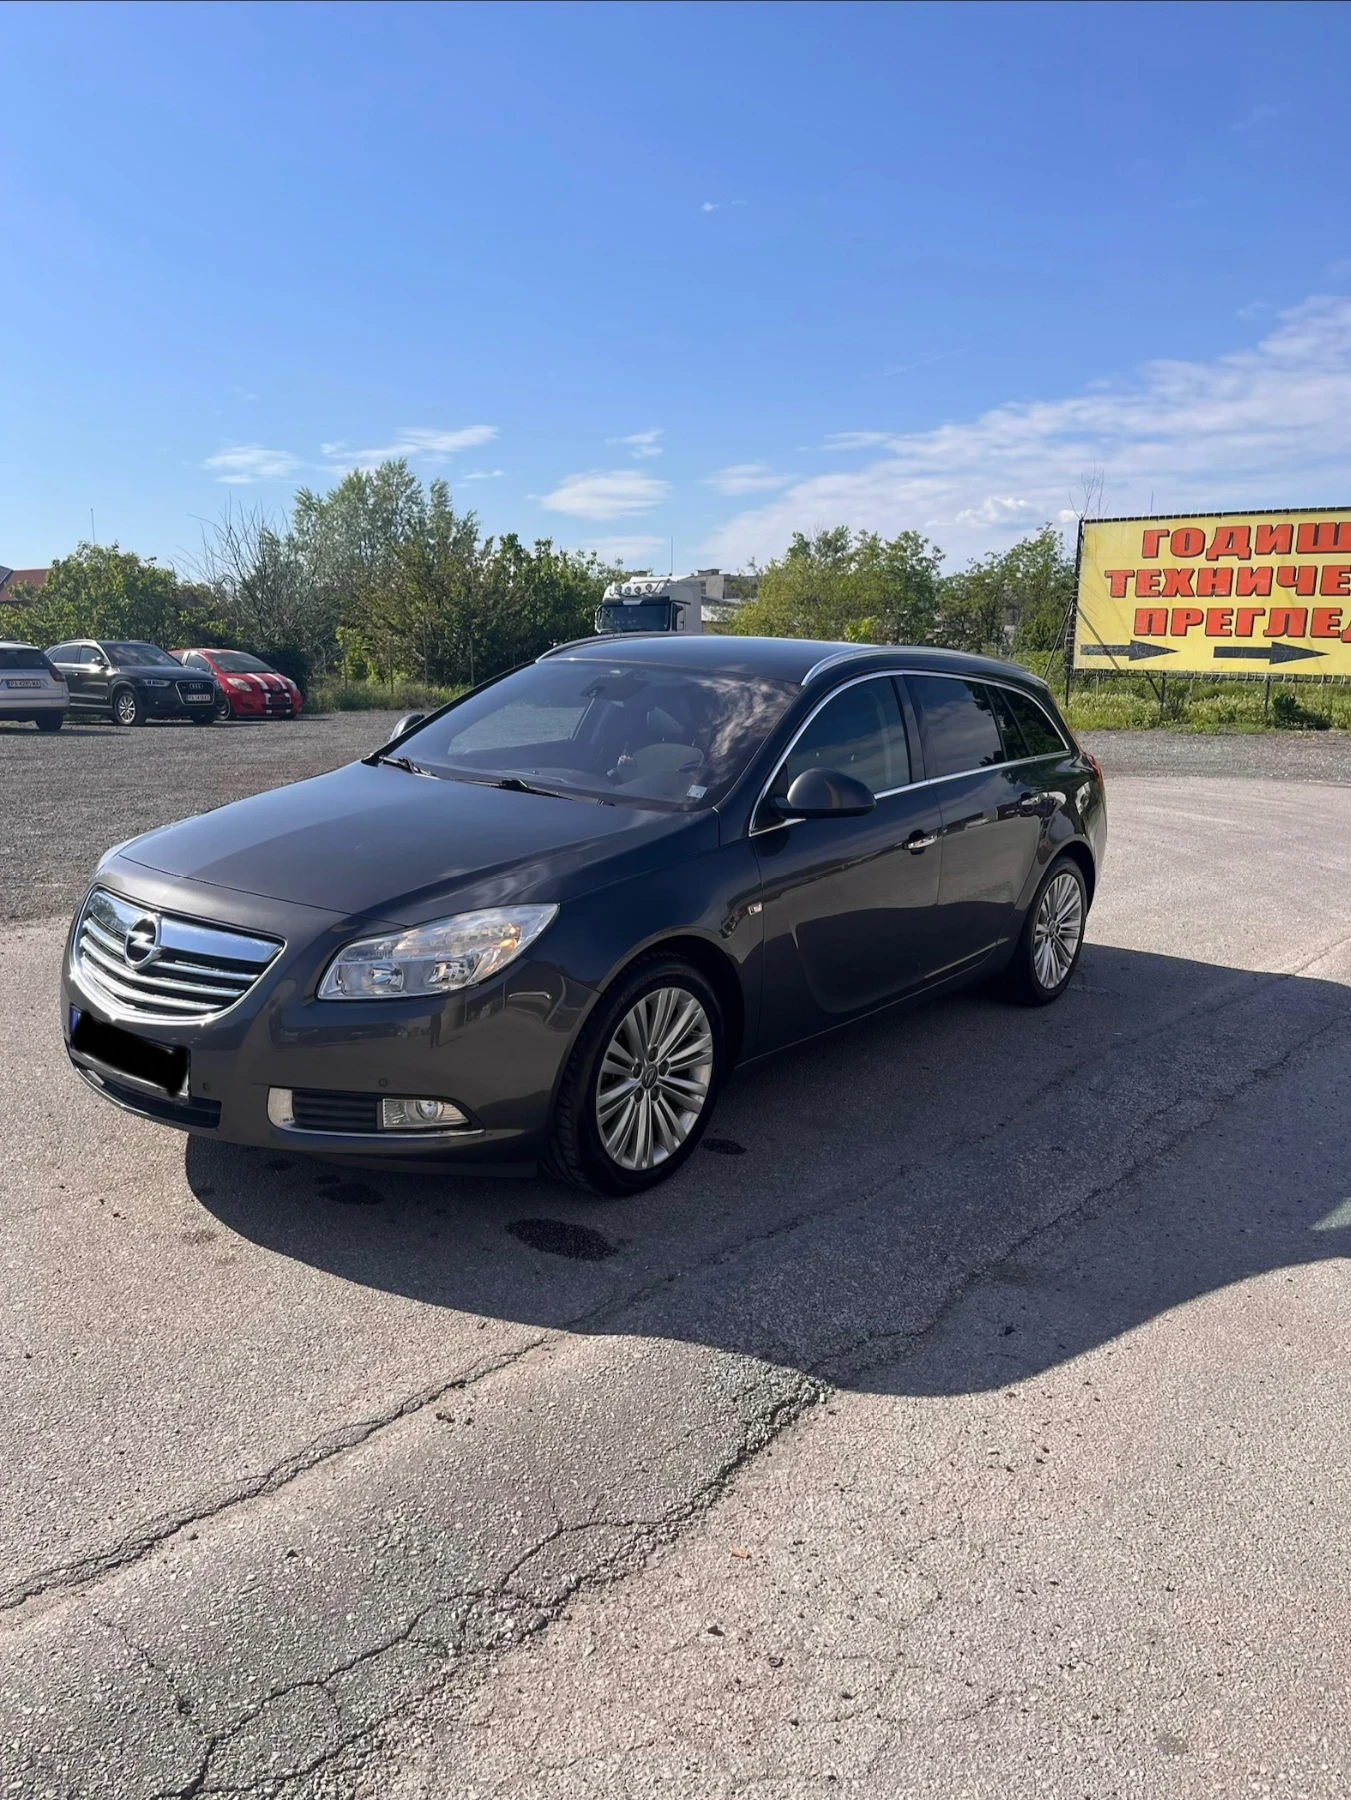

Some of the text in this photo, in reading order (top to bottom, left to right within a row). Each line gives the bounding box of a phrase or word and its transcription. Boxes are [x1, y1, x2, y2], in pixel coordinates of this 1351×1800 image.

[1141, 521, 1351, 561] ГОДИШ
[1104, 565, 1351, 598] ТЕХНИЧЕ
[1133, 607, 1351, 643] ПРЕГЛЕ
